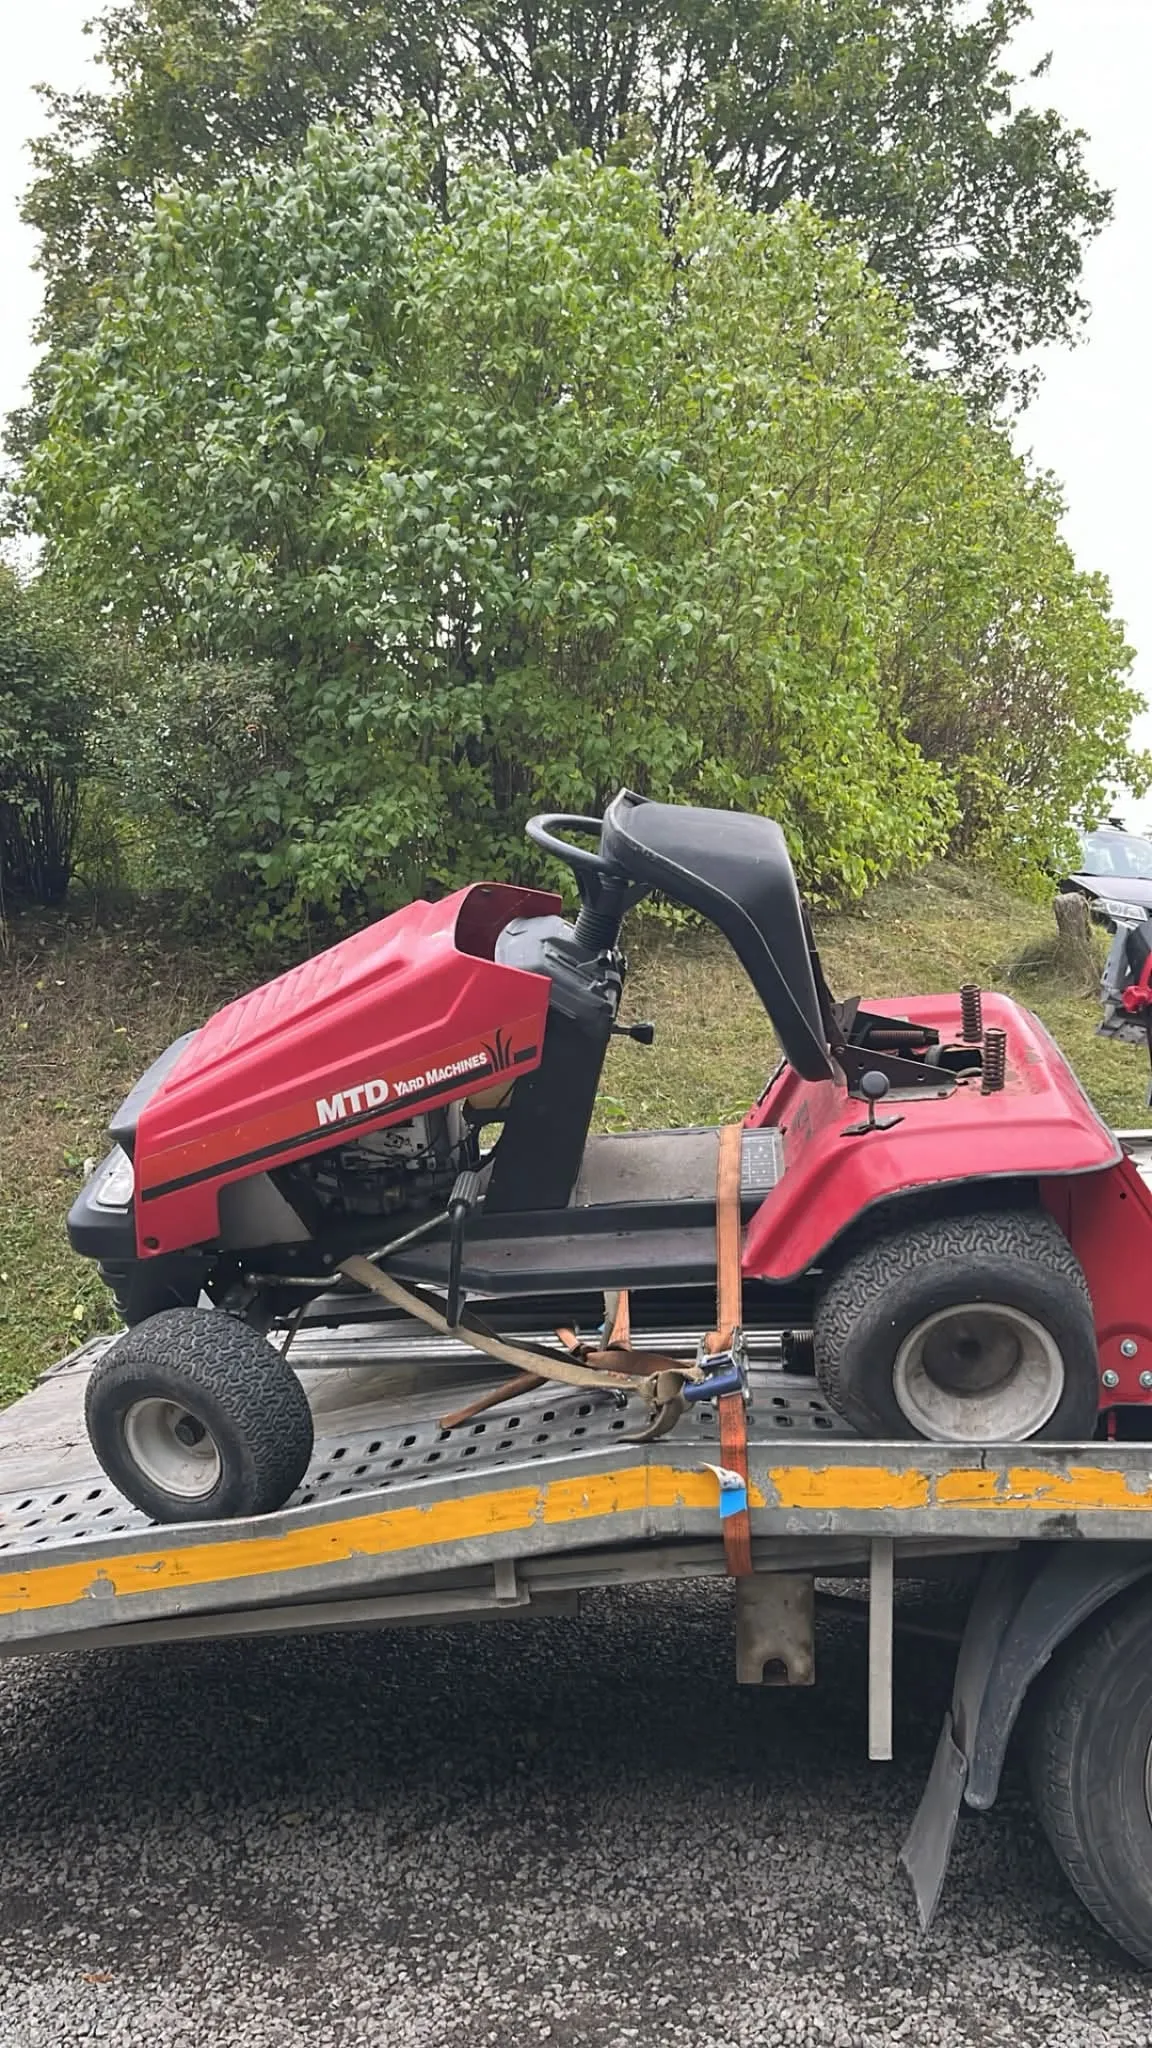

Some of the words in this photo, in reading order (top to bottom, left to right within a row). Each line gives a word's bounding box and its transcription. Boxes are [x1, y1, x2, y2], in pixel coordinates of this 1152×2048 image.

[316, 1079, 388, 1125] MTD
[393, 1077, 425, 1096] YARD
[426, 1052, 488, 1085] MACHINES
